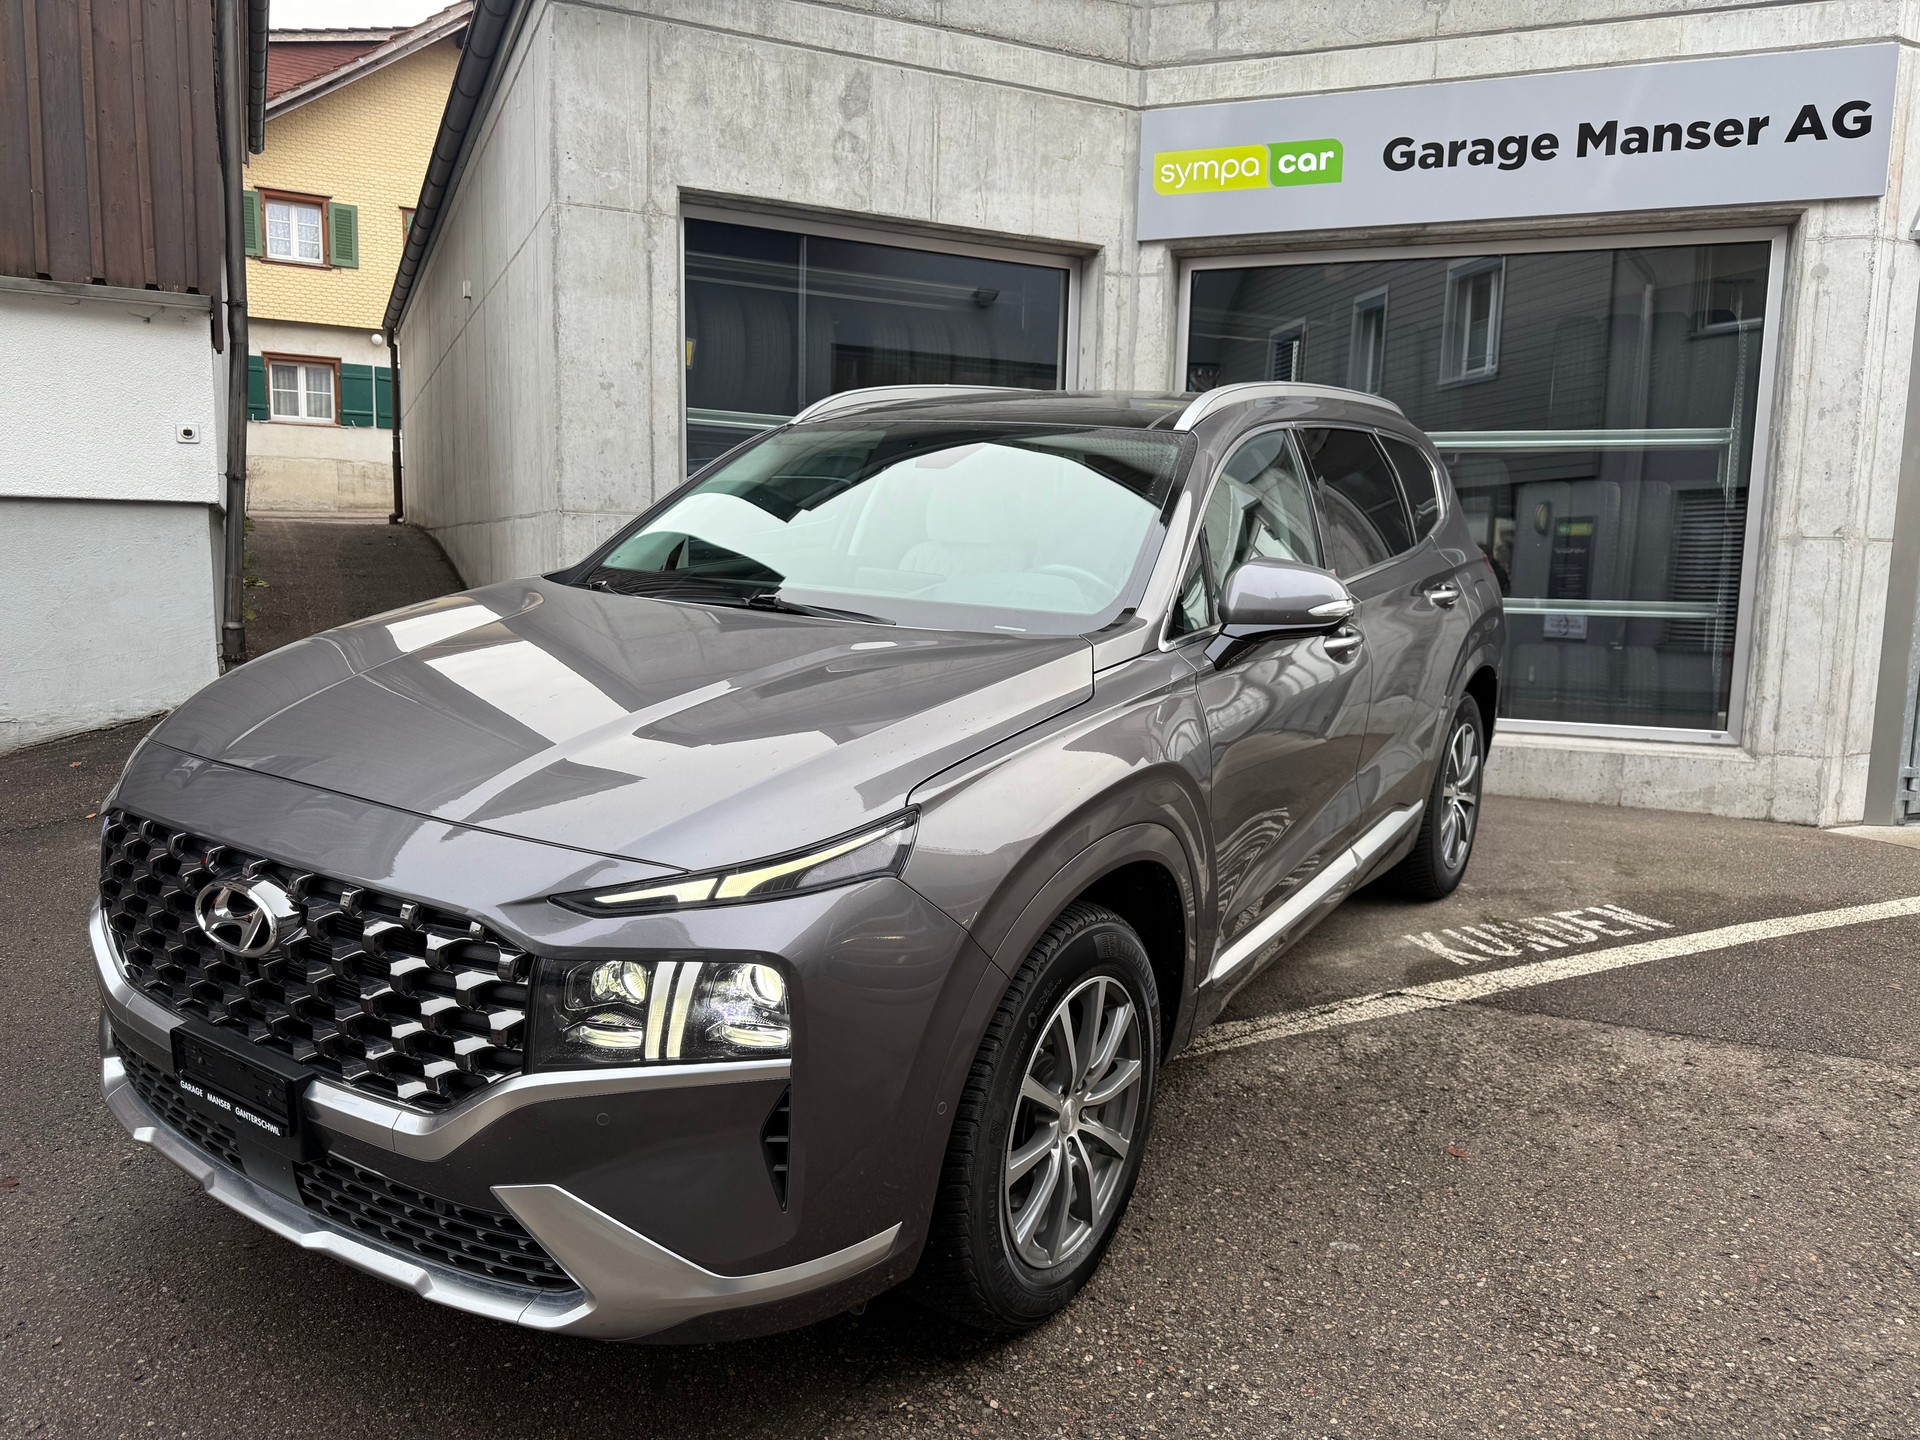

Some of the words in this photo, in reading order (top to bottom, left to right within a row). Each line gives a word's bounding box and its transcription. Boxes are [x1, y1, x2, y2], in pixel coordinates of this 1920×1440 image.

[1382, 132, 1559, 172] Garage
[1576, 115, 1770, 158] Manser
[1783, 100, 1873, 143] AG
[1160, 157, 1260, 189] sympa
[1278, 150, 1335, 174] car
[1402, 904, 1675, 965] KUNDEN
[180, 1080, 203, 1097] GARAGE
[207, 1092, 231, 1111] MANSER
[235, 1107, 281, 1136] GANTERSCHWIL
